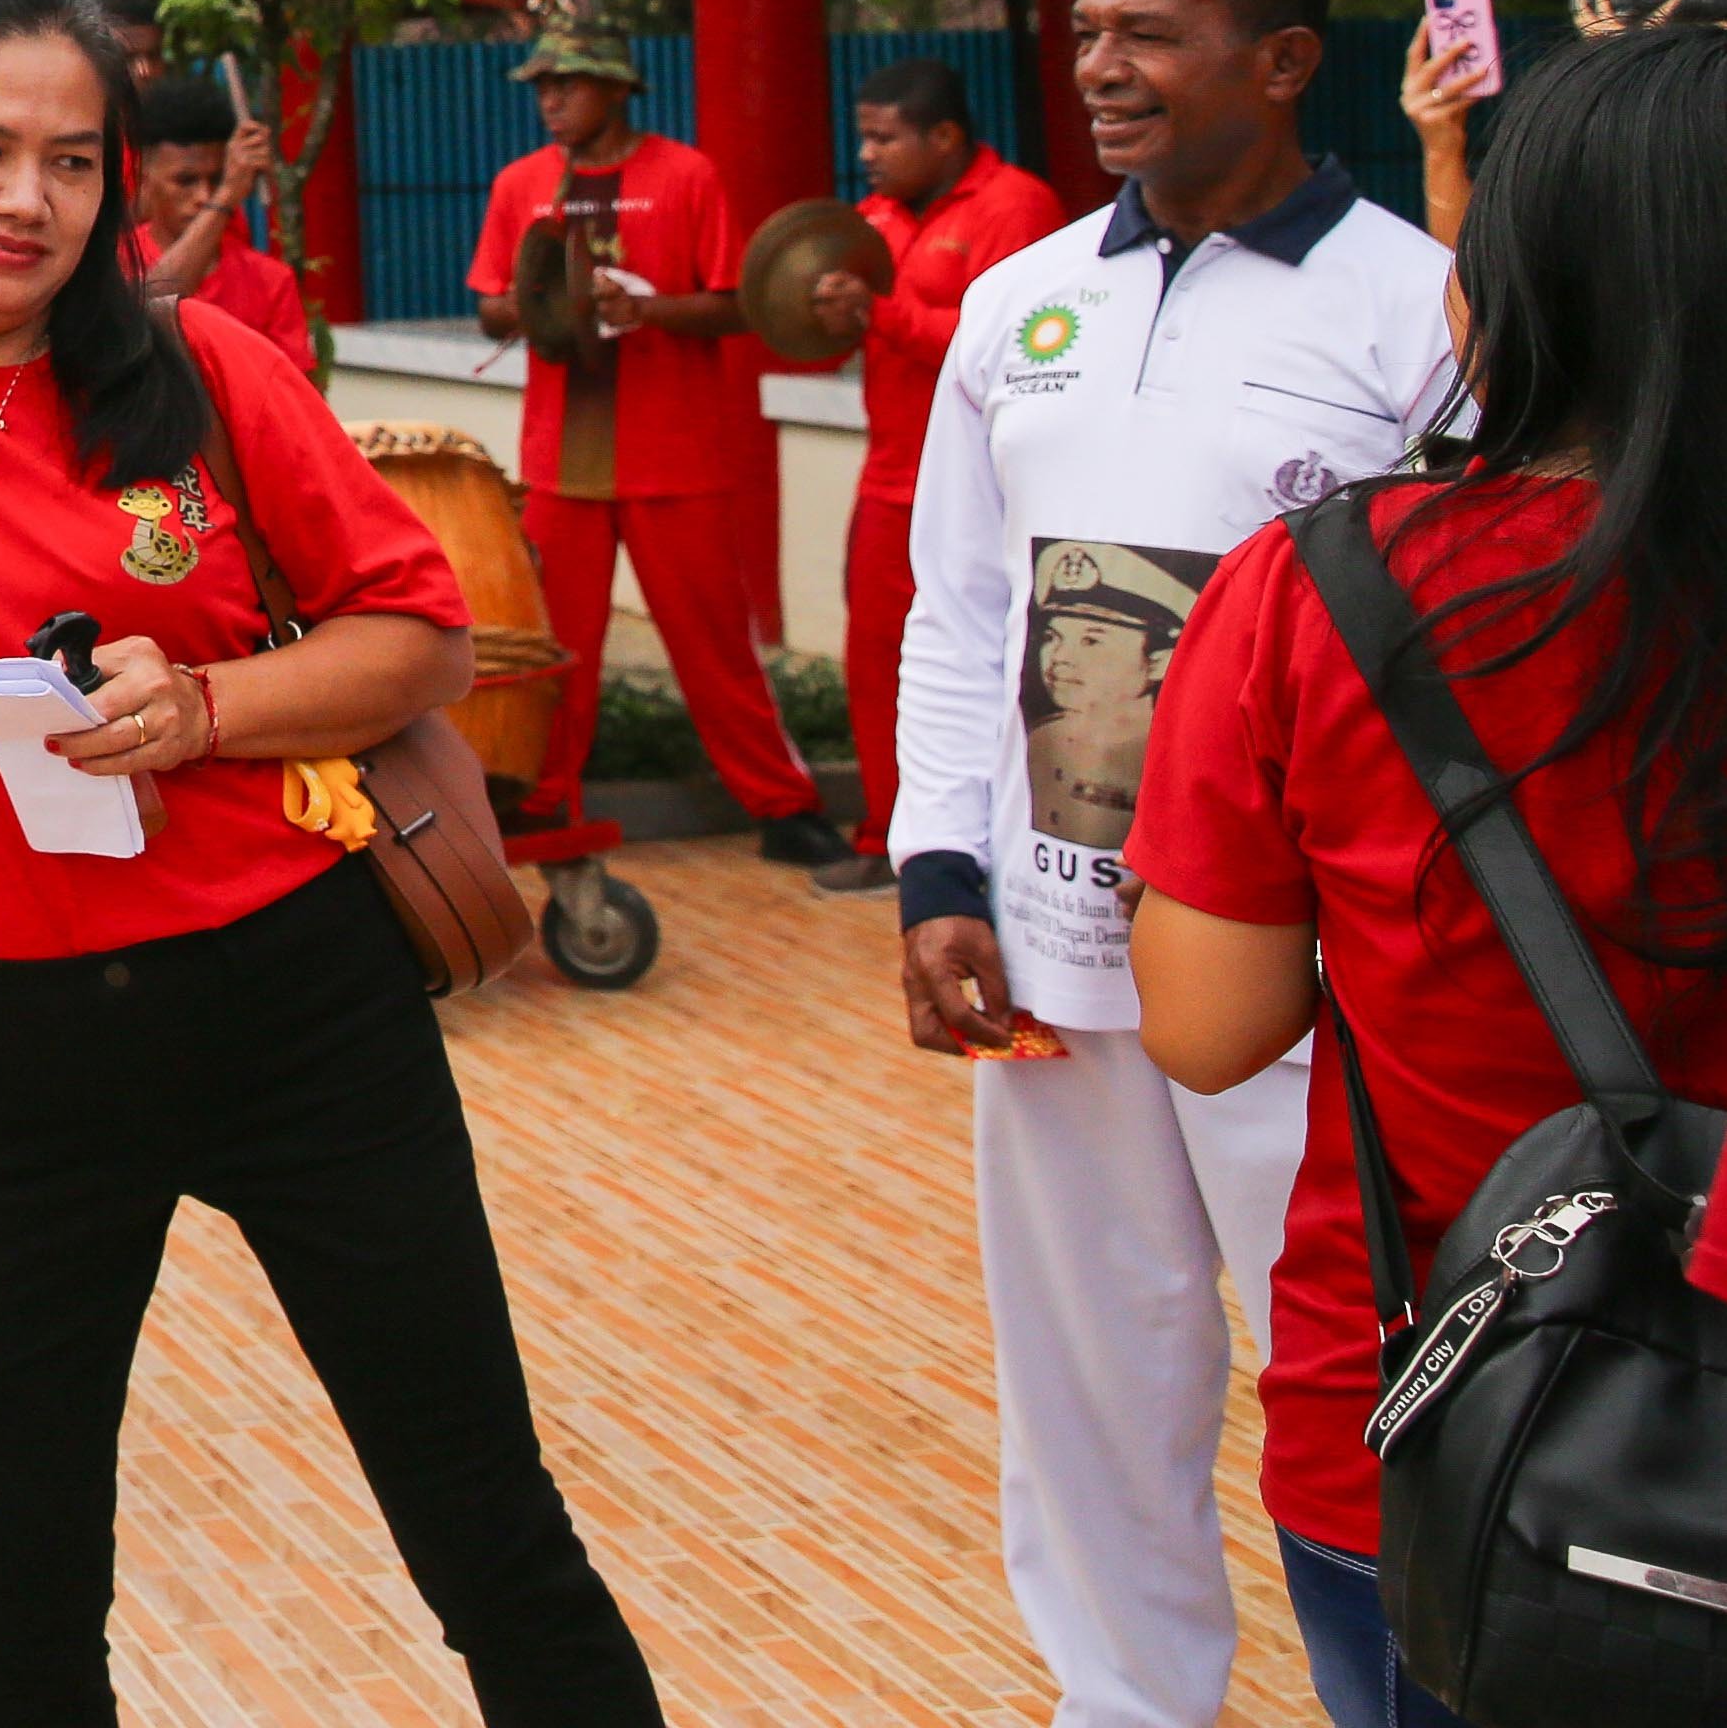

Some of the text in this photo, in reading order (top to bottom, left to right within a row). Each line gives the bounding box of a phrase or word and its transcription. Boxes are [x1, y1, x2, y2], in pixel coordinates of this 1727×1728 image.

[1079, 288, 1109, 306] bp
[1425, 1339, 1455, 1372] City
[1458, 1288, 1496, 1325] LOS
